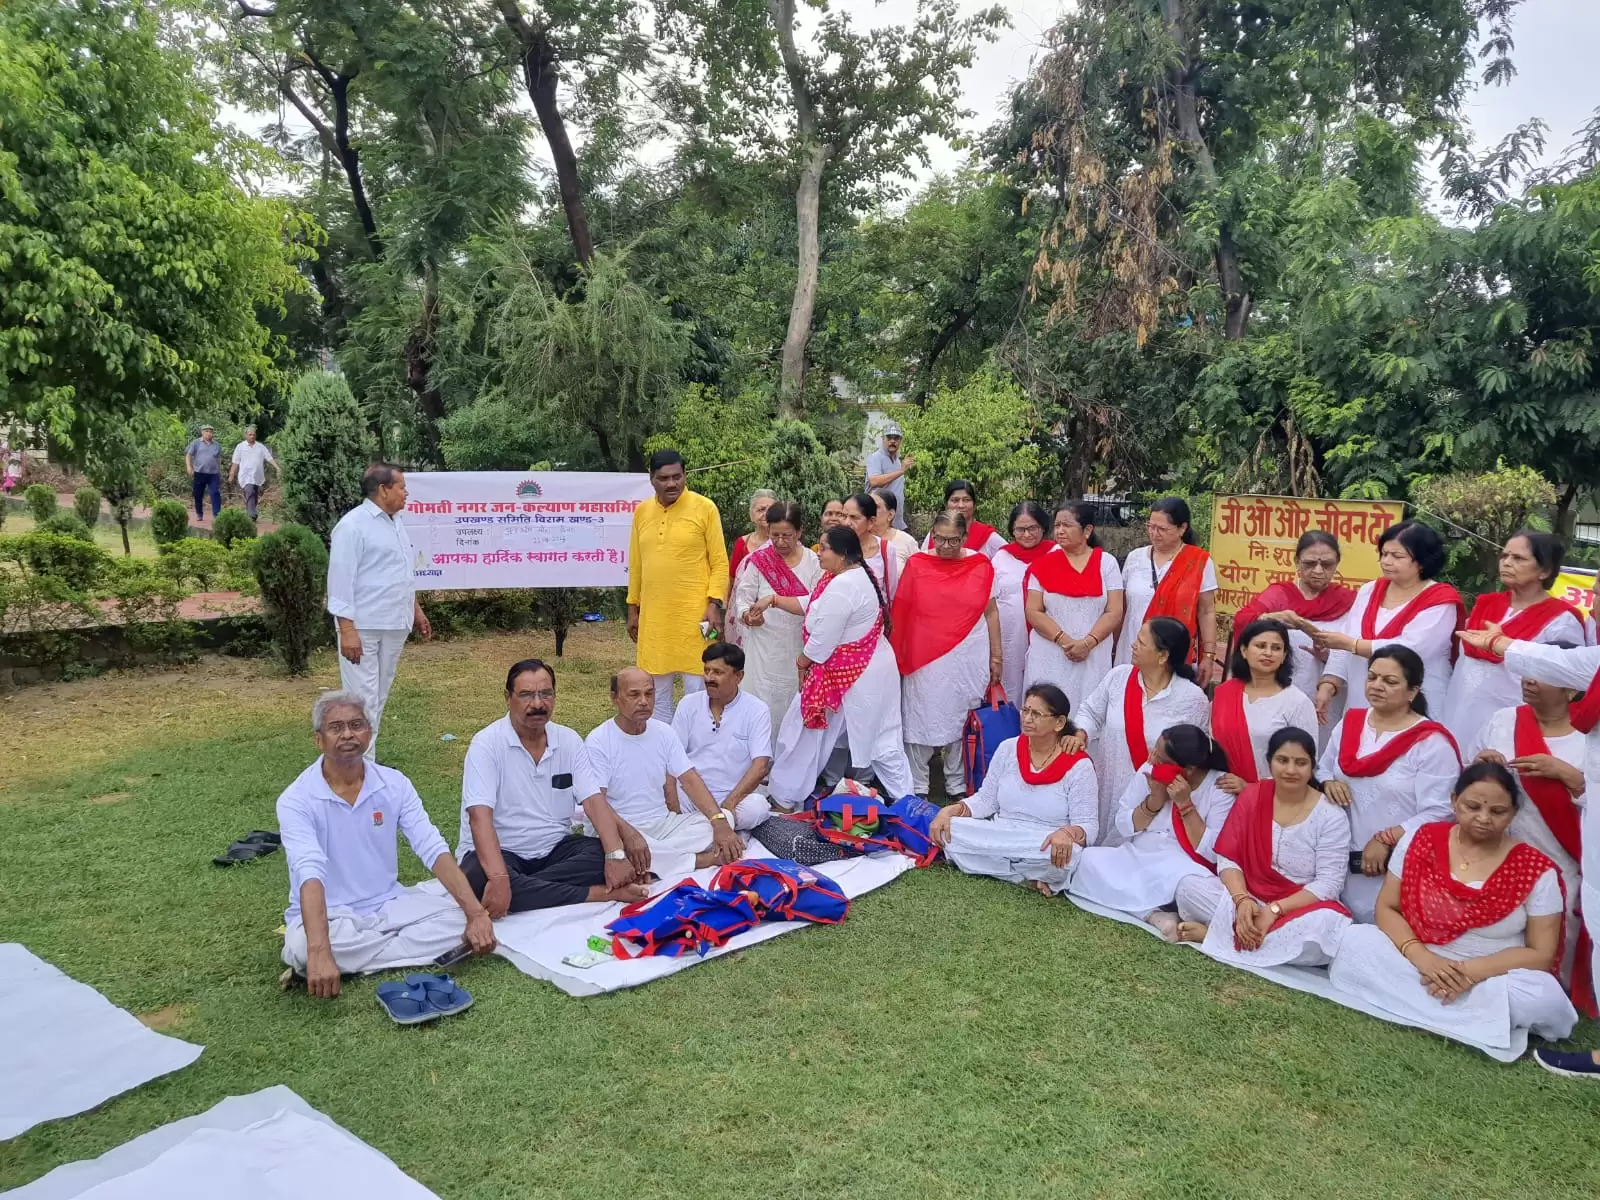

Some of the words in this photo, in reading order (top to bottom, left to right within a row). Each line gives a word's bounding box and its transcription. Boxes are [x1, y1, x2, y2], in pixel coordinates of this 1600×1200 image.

[407, 500, 453, 514] गोमती
[456, 502, 487, 513] नगर
[579, 500, 642, 513] महासमि
[535, 514, 564, 523] विराम
[1315, 501, 1368, 544] जीवन
[432, 553, 477, 564] आपका
[482, 550, 522, 565] हार्दिक
[527, 552, 567, 563] स्वागत
[572, 549, 604, 562] करती
[1218, 560, 1259, 585] योग
[1215, 587, 1259, 608] भारती
